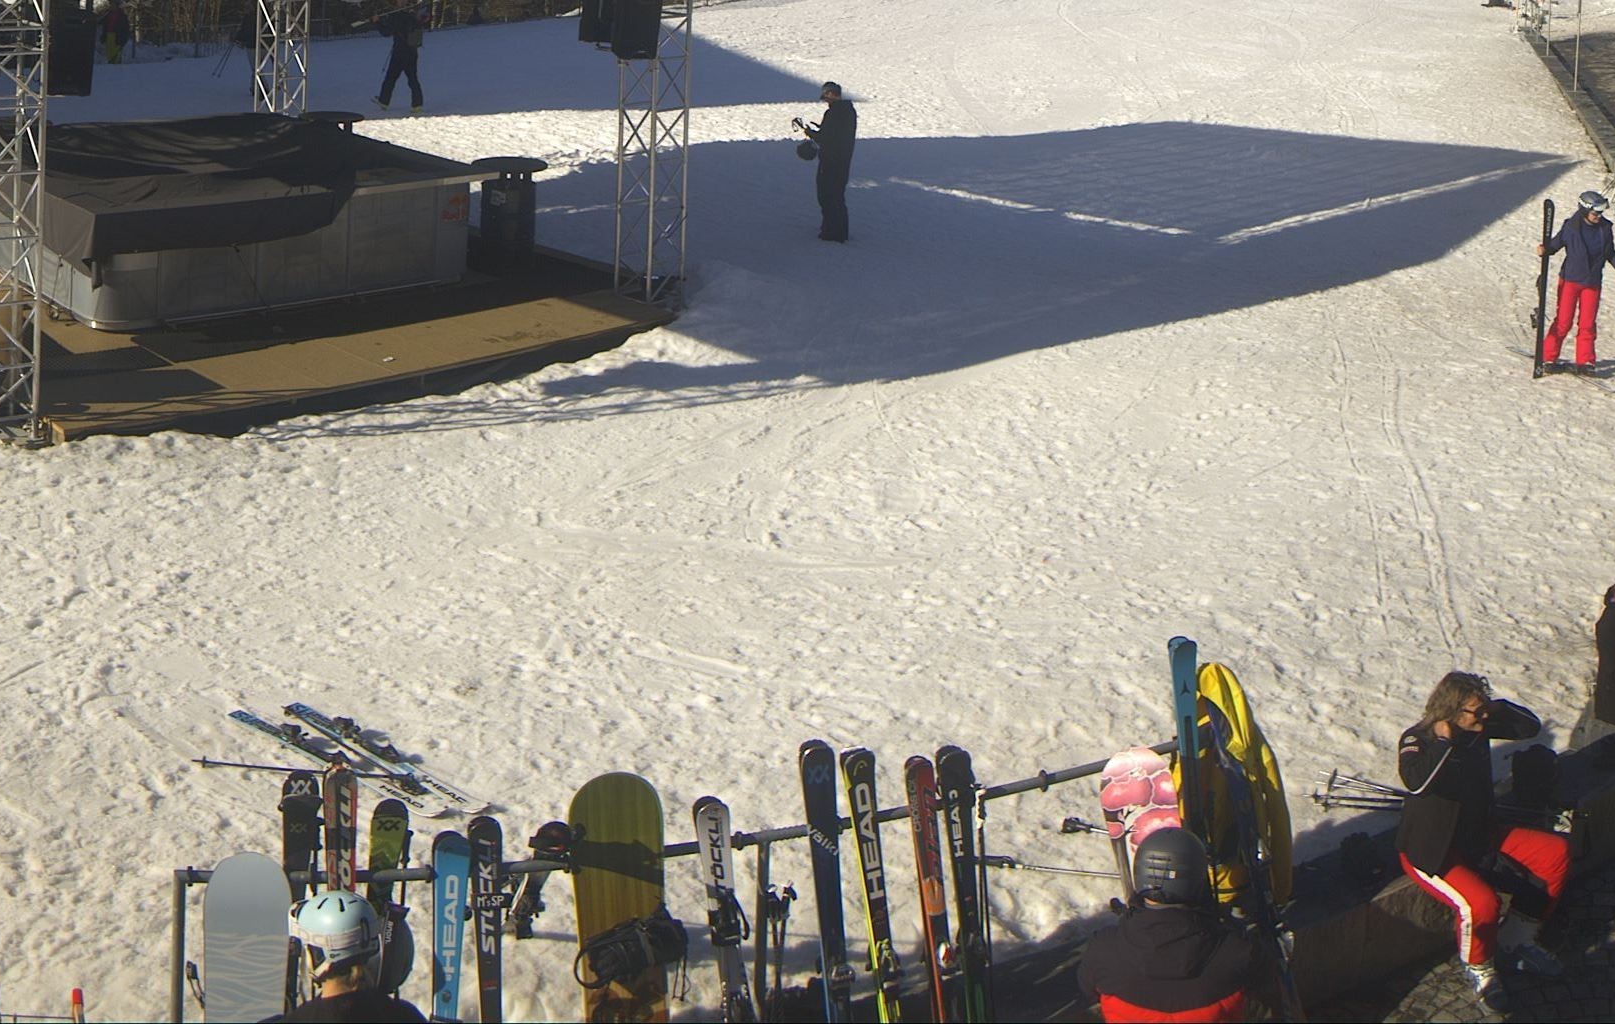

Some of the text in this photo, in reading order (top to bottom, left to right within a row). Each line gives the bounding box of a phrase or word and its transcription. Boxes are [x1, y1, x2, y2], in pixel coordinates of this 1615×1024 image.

[379, 785, 424, 809] HEAD
[855, 782, 885, 901] HEAD
[478, 838, 496, 956] STCKLI
[708, 816, 727, 893] TÖCKLI
[442, 874, 460, 974] HEAD
